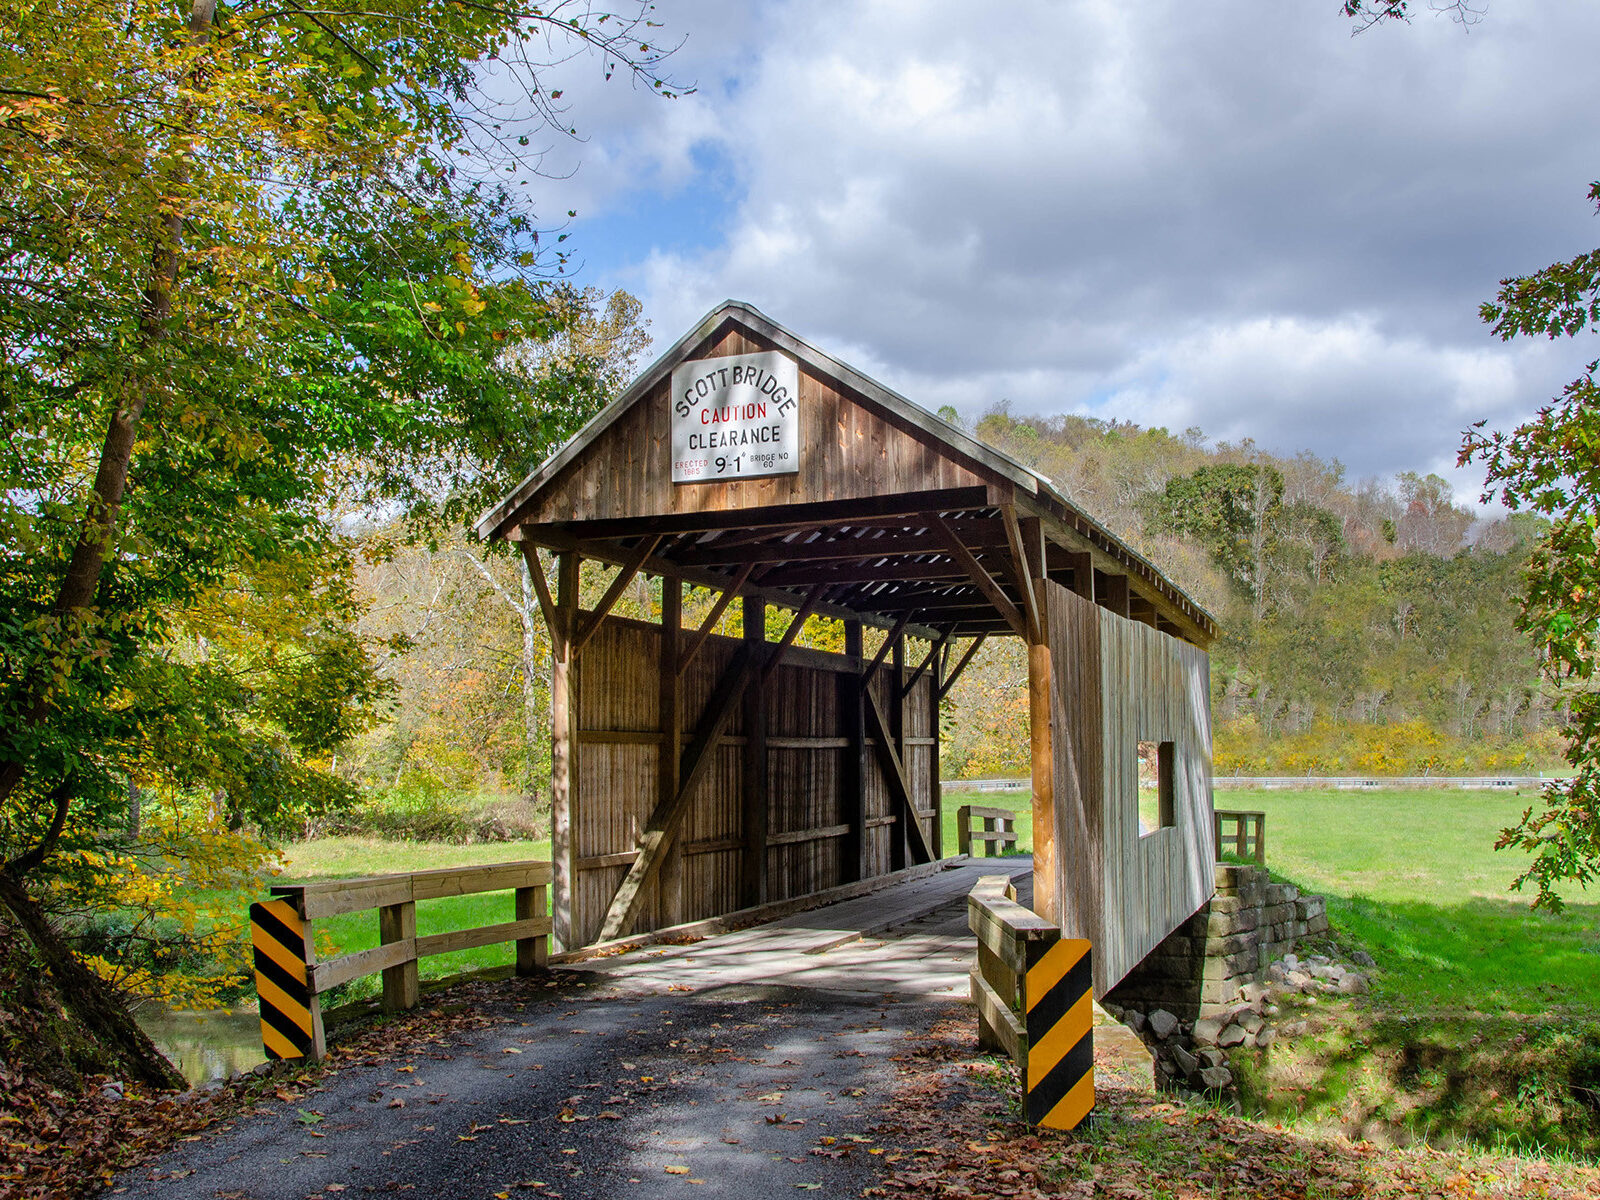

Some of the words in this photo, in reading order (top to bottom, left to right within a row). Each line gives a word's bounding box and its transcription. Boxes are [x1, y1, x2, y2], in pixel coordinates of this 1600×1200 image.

[675, 368, 728, 418] SCOTT
[733, 366, 796, 418] BRIDGE
[701, 402, 766, 424] CAUTION
[689, 426, 780, 449] CLEARANCE
[675, 459, 708, 469] ERECTED
[750, 453, 775, 462] BRIDGE
[778, 452, 788, 460] NO
